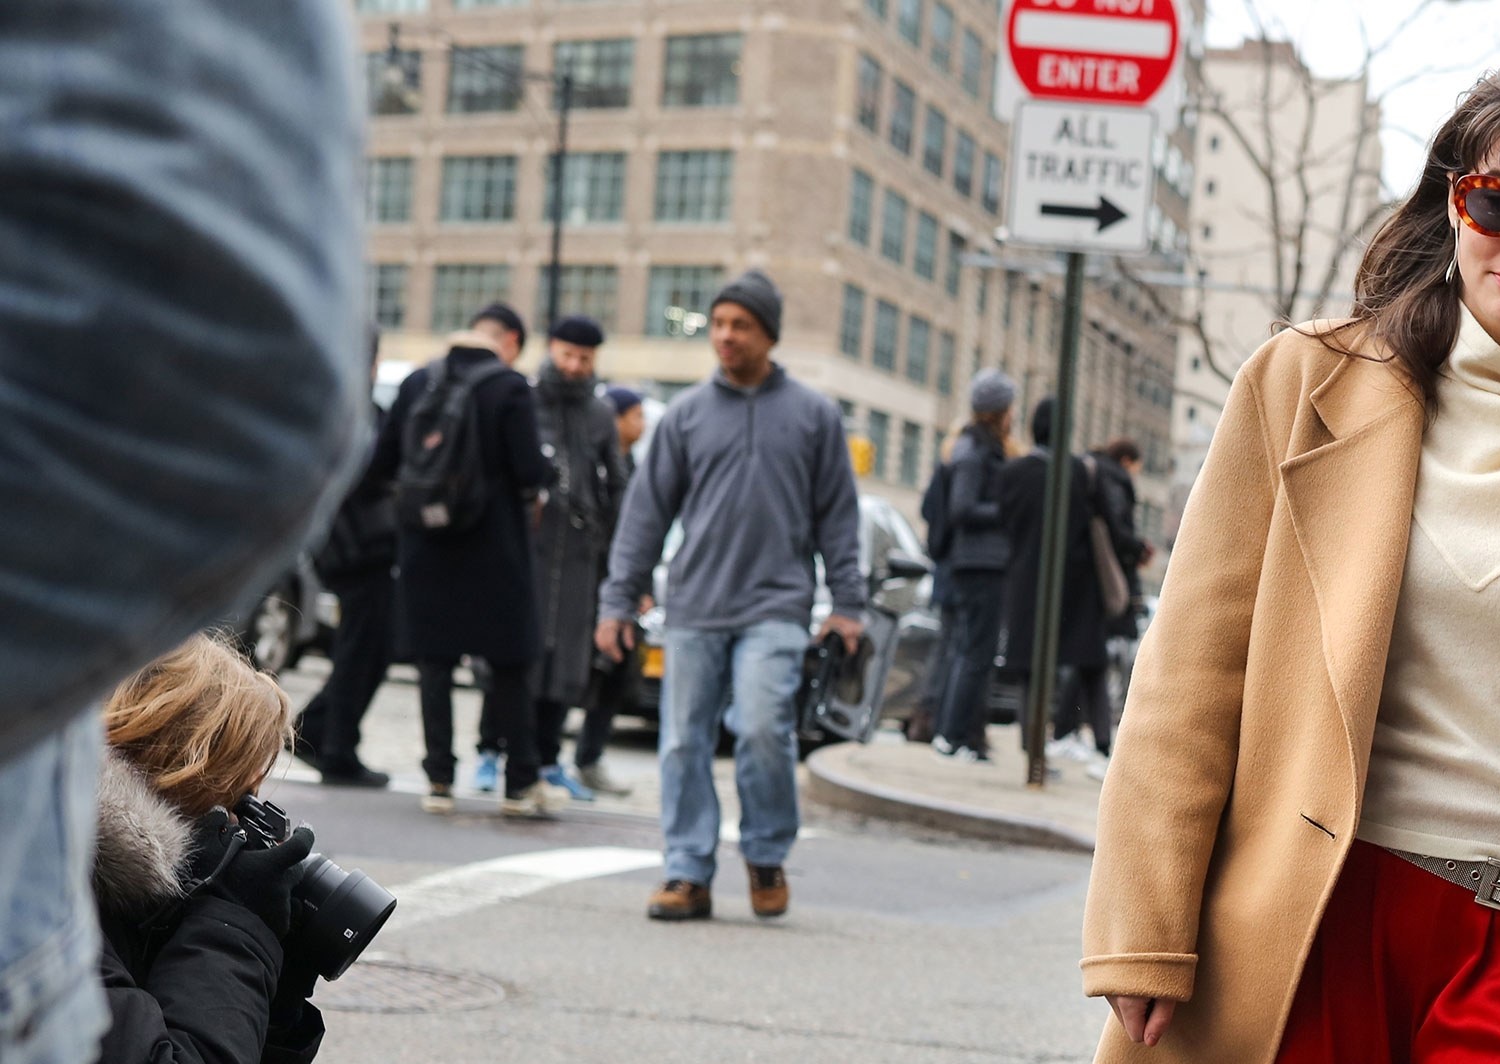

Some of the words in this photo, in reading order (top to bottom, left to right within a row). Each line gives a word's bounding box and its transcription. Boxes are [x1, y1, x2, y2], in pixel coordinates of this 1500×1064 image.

[1038, 54, 1141, 95] ENTER
[1053, 116, 1117, 149] ALL
[1026, 153, 1141, 190] TRAFFIC
